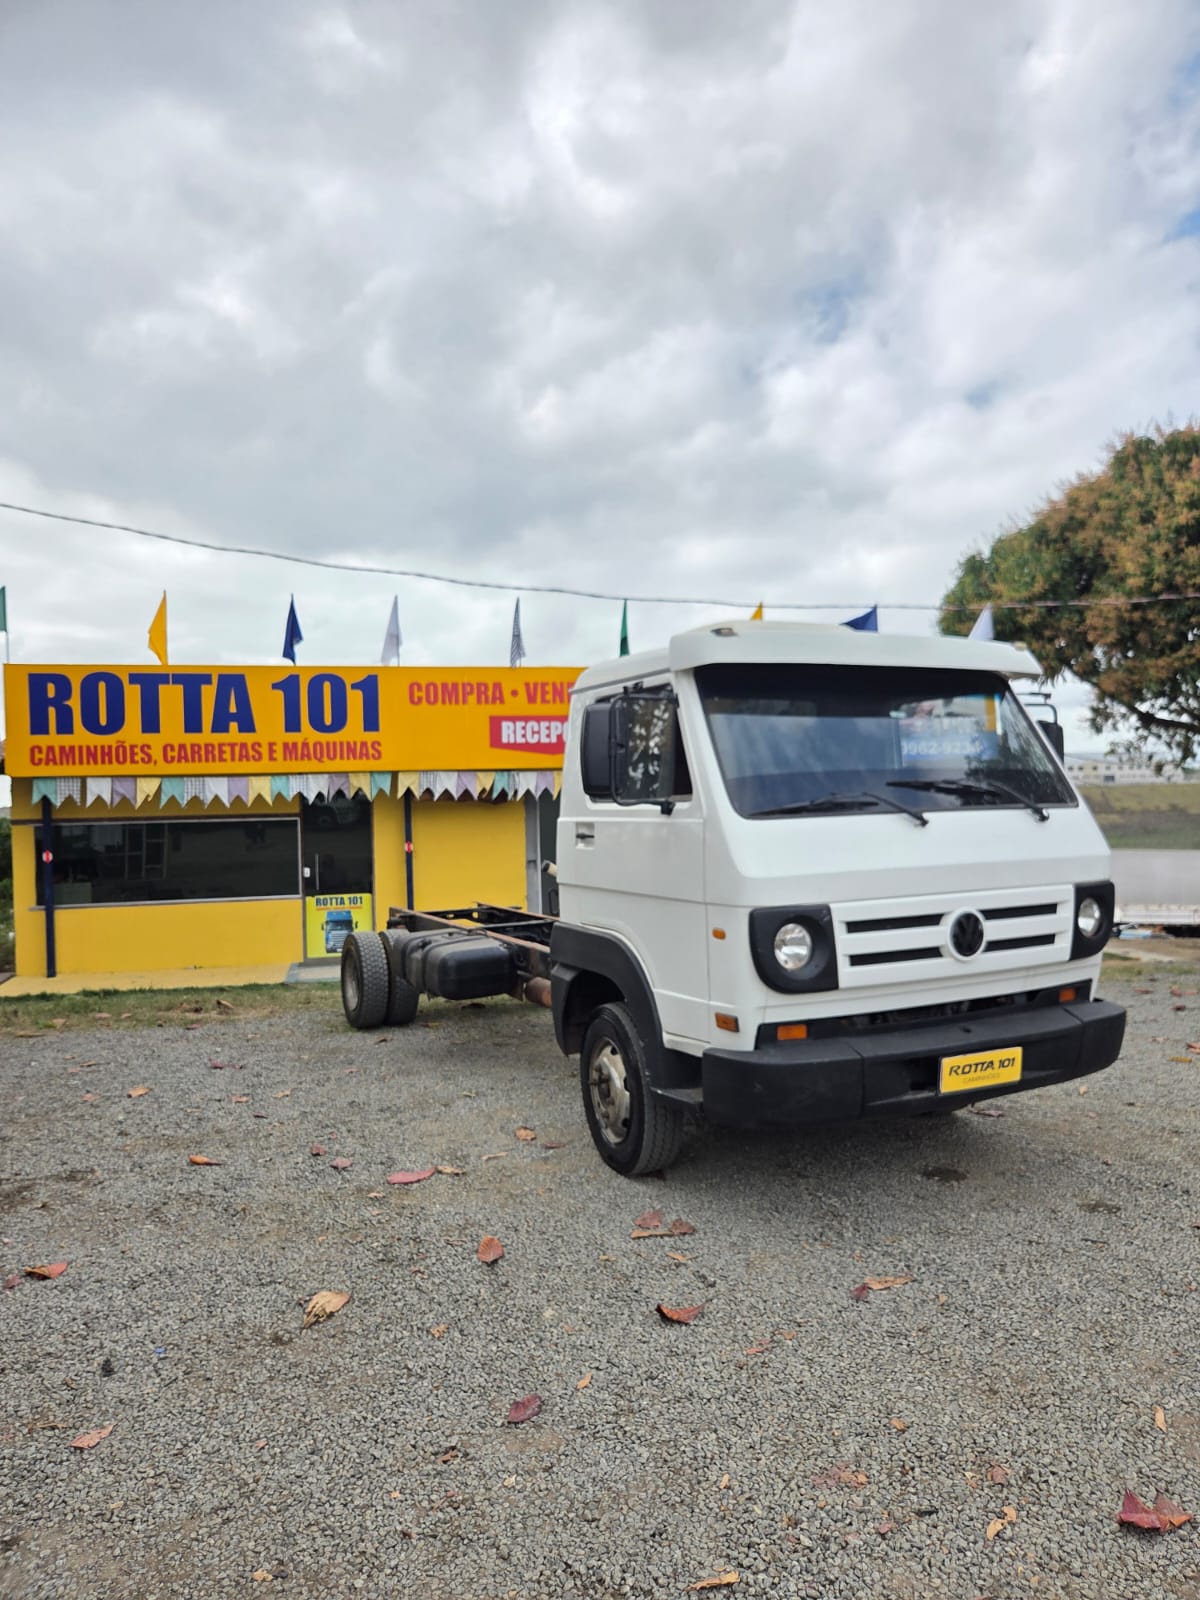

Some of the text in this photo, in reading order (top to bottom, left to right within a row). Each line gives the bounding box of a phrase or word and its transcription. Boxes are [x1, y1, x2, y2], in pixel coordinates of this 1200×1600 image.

[28, 671, 380, 735] ROTTA 101
[408, 682, 506, 706] COMPRA
[30, 738, 382, 767] CAMINHÕES, CARRETAS E MÁQUINAS
[315, 896, 363, 907] ROTTA 101
[948, 1057, 1016, 1077] ROTTA 101
